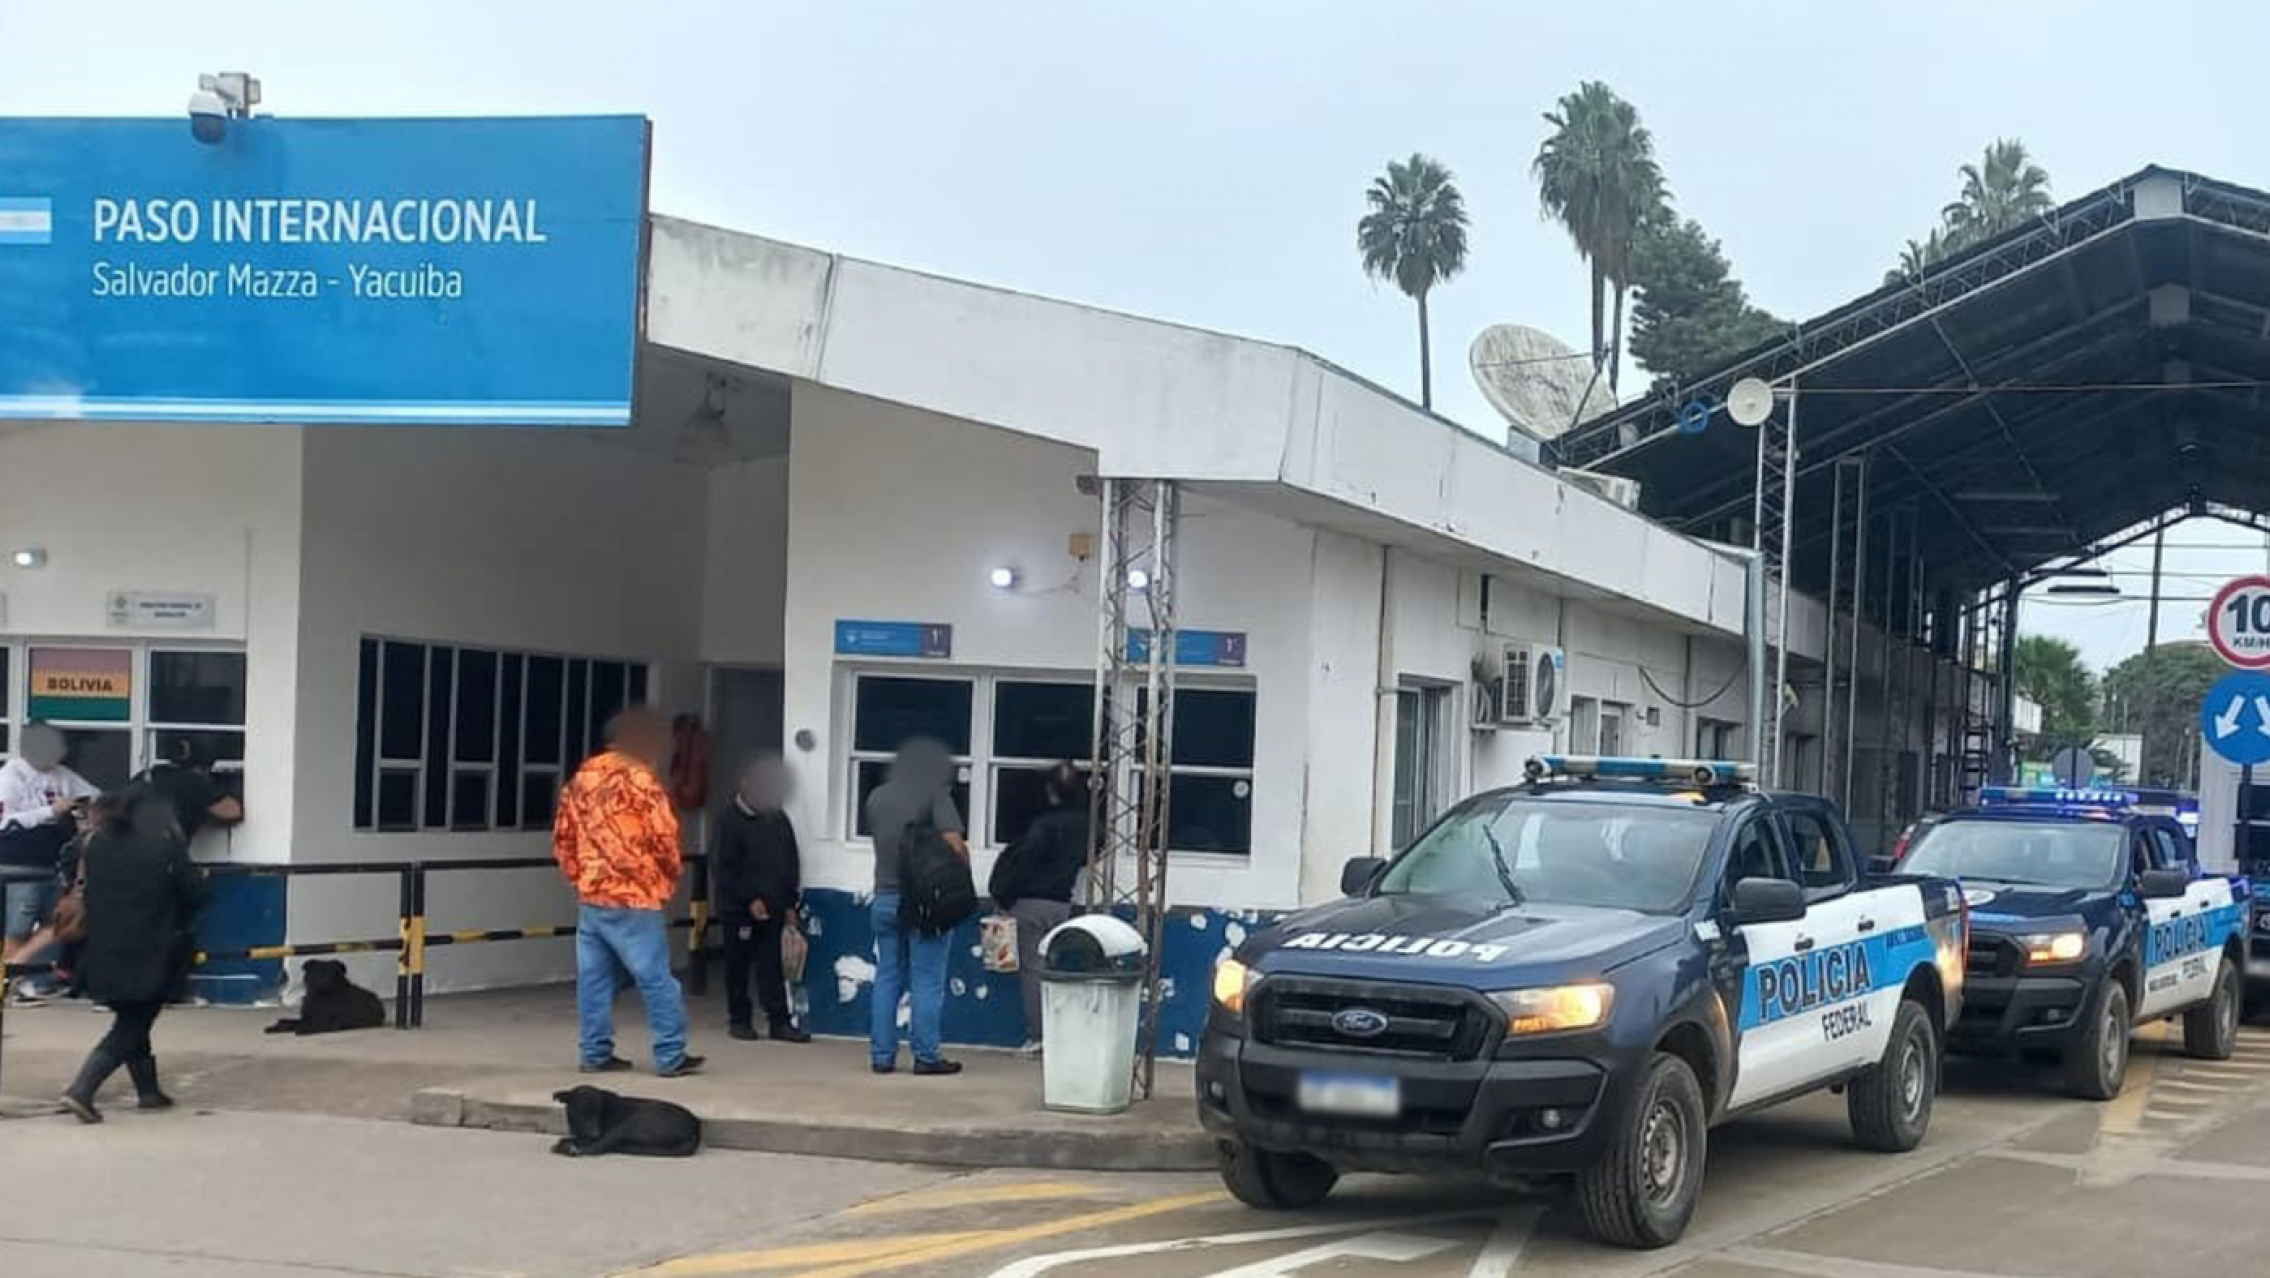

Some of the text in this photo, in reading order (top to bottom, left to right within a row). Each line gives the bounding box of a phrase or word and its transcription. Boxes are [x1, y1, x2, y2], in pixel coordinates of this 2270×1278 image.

[94, 199, 547, 243] PASO INTERNACIONAL
[92, 261, 462, 298] Salvador Mazza - Yacuiba
[2226, 593, 2270, 633] 10
[47, 677, 113, 692] BOLIVIA
[1757, 943, 1870, 1022] POLICIA
[1821, 1002, 1872, 1042] FEDERAL
